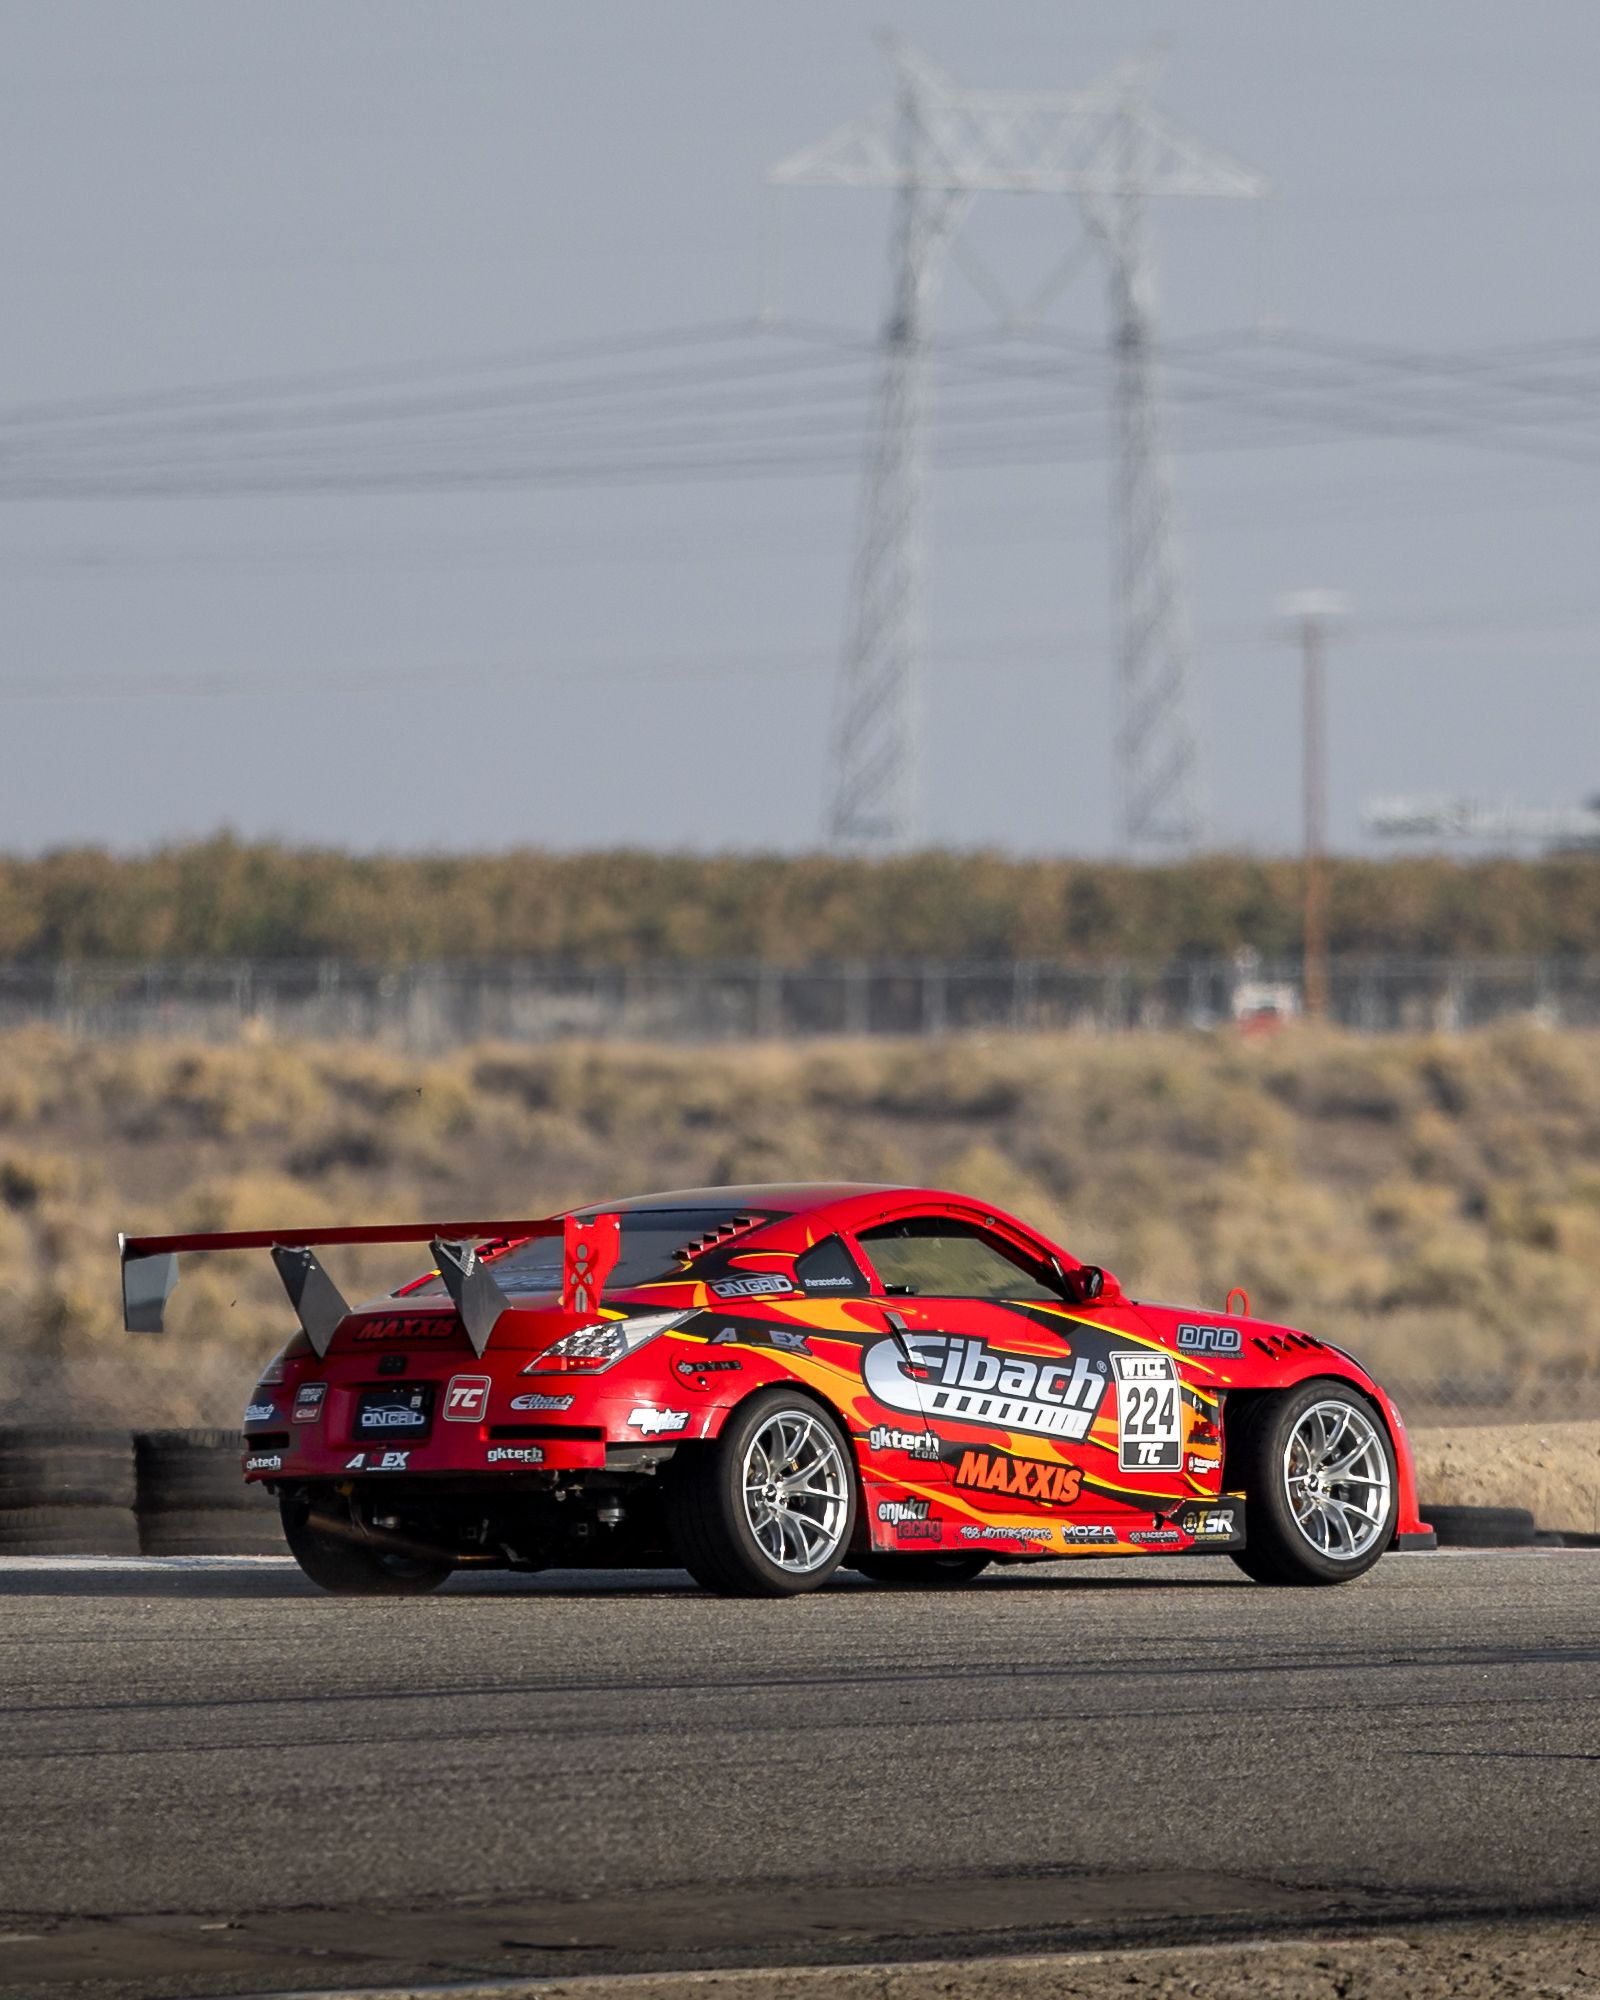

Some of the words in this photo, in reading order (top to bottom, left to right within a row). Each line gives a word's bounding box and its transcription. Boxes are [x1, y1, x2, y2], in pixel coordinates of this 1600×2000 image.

[357, 1319, 456, 1339] MAXXIS
[1121, 1359, 1166, 1377] WTCC
[450, 1388, 484, 1408] TC
[865, 1335, 1106, 1440] Eibach
[511, 1395, 574, 1411] Eibach
[1124, 1387, 1174, 1435] 224
[870, 1427, 939, 1451] gktech
[488, 1447, 543, 1462] gktech
[1138, 1443, 1163, 1464] TC
[956, 1451, 1082, 1500] MAXXIS
[879, 1498, 929, 1525] enjuku
[1196, 1510, 1234, 1532] ISR
[899, 1520, 941, 1541] racing
[982, 1527, 1052, 1539] MOTORSPORTS
[1062, 1526, 1116, 1537] MOZA
